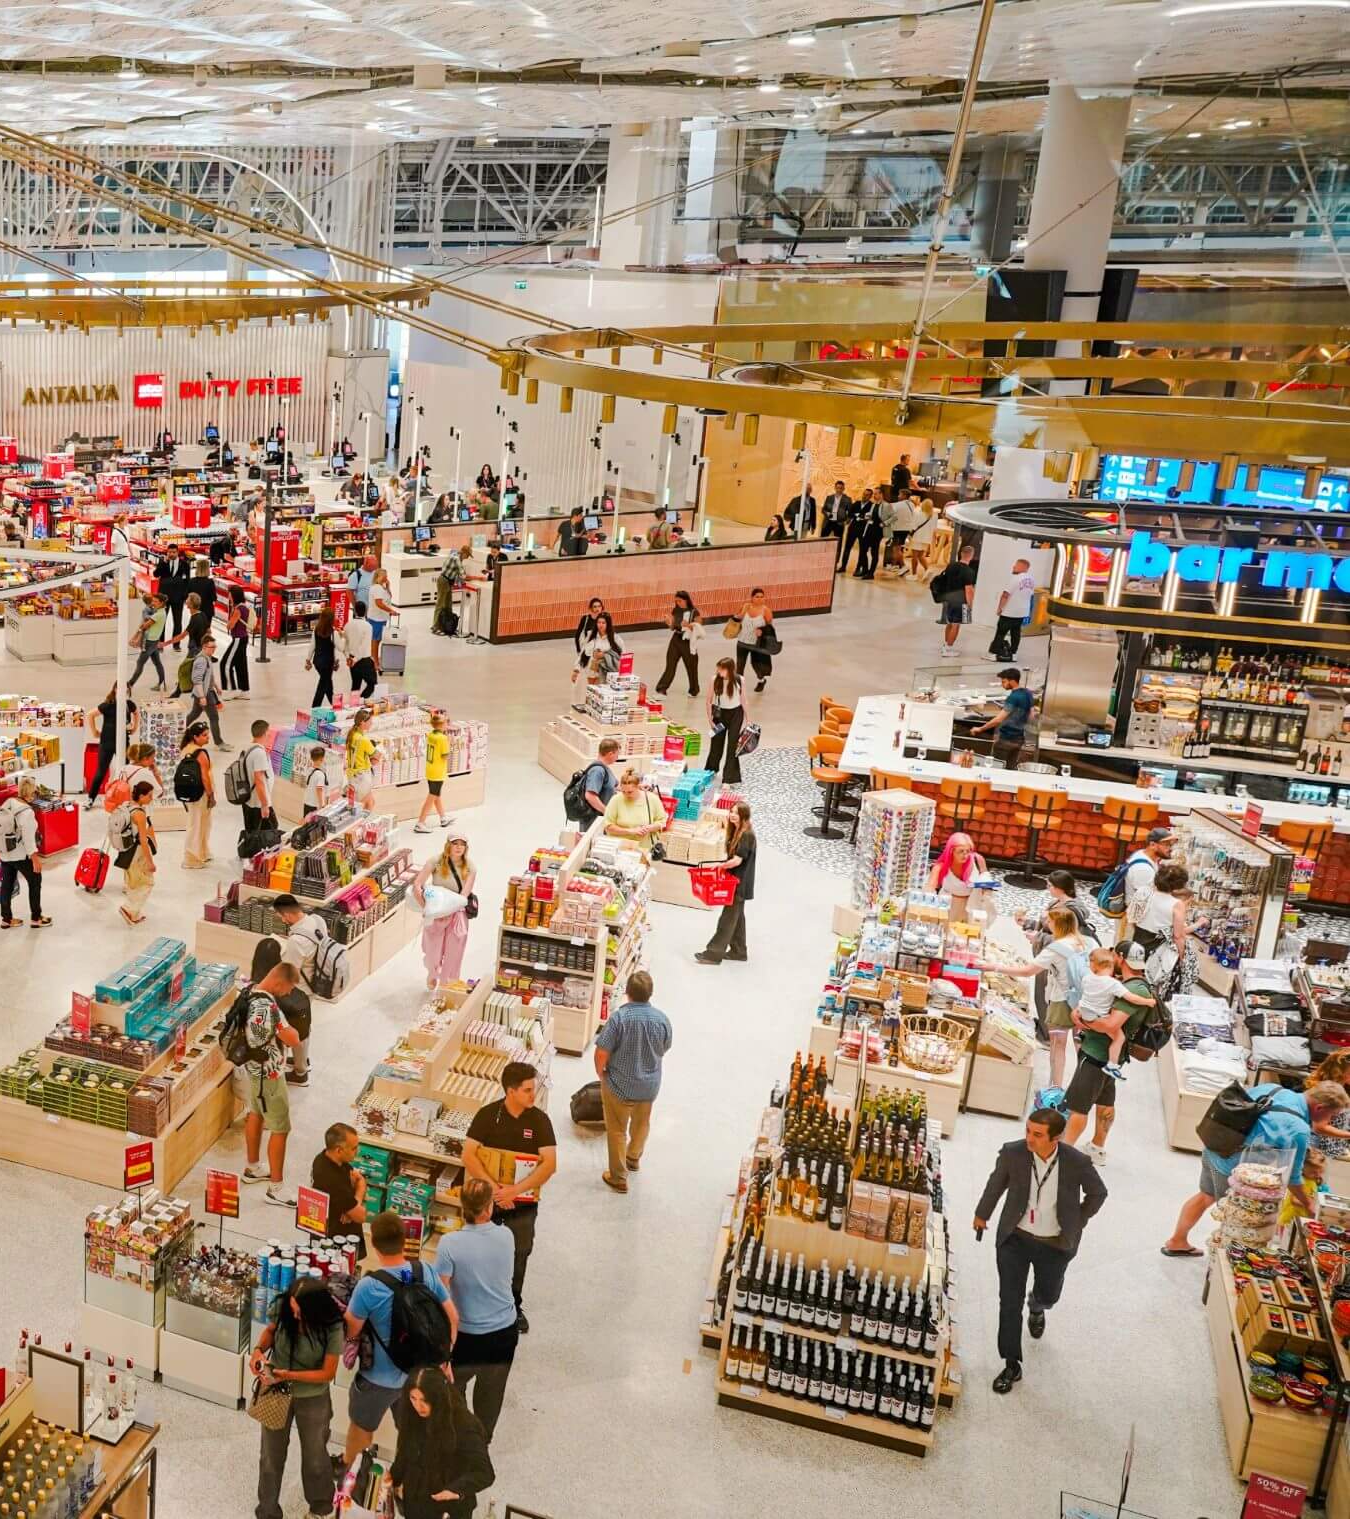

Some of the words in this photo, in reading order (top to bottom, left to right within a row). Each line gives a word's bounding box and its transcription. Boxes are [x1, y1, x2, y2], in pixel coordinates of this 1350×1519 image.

[22, 384, 119, 406] ANTALYA
[179, 379, 240, 400] DUTY
[247, 377, 303, 397] FREE
[1127, 531, 1254, 583] bar
